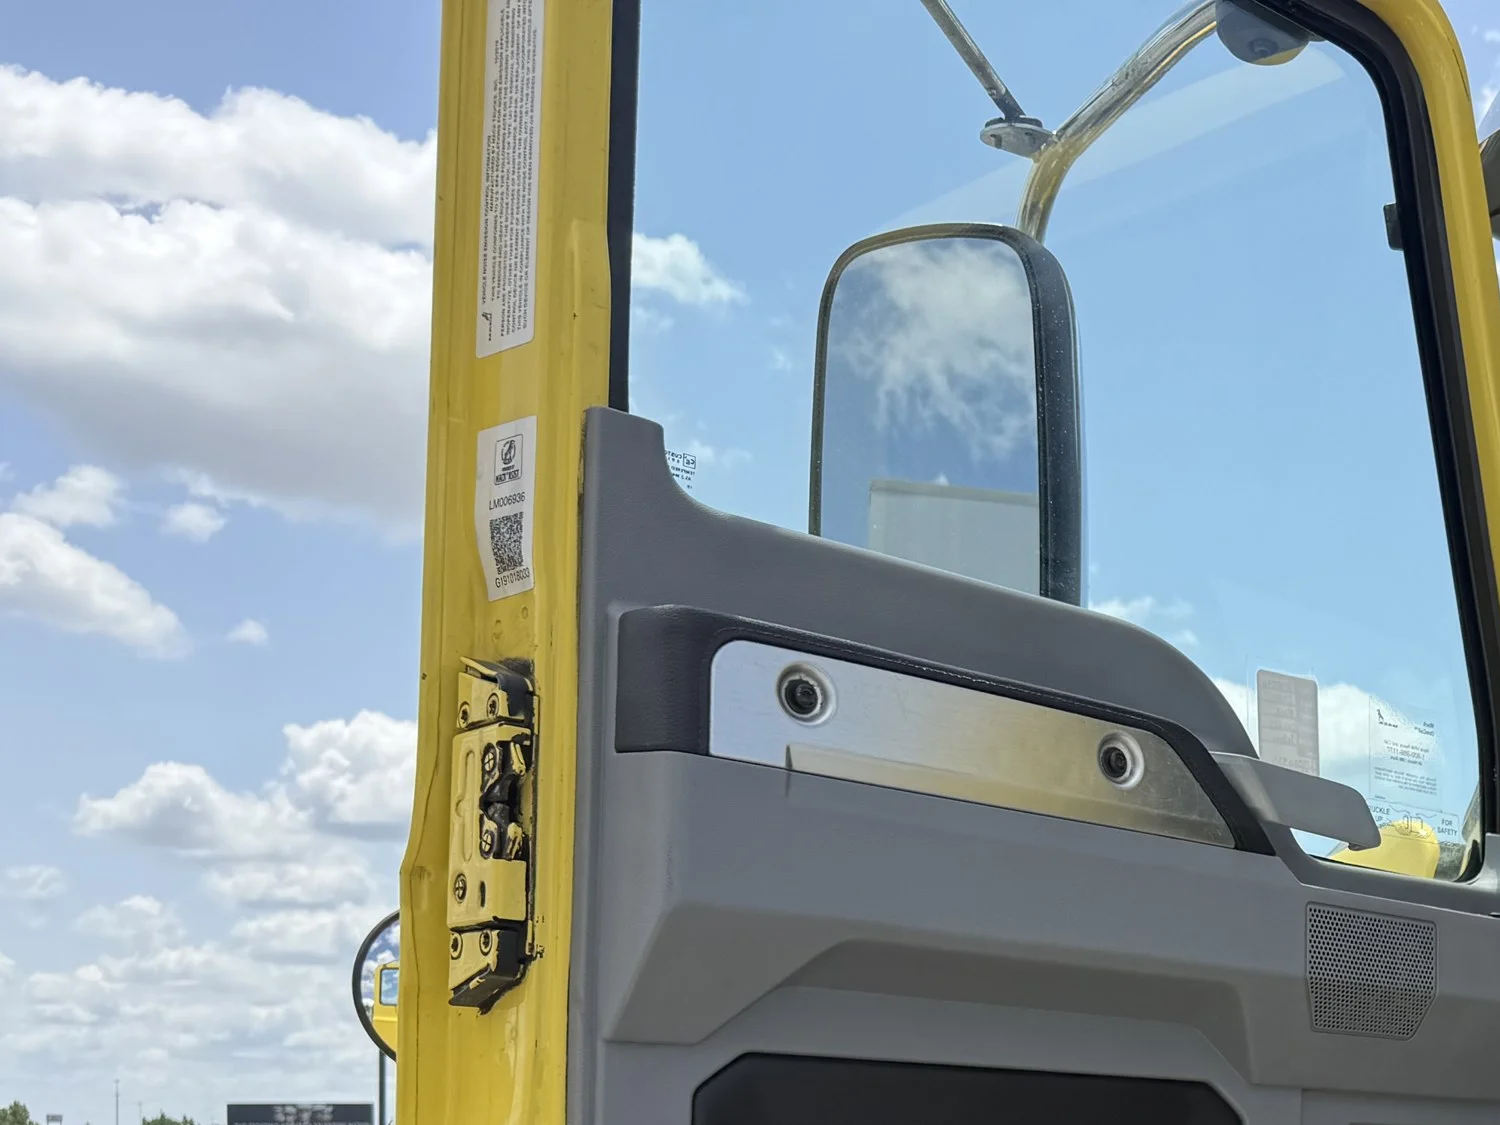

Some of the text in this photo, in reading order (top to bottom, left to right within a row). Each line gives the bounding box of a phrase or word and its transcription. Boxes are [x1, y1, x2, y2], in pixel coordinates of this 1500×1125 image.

[489, 492, 525, 510] LM006936
[1369, 806, 1390, 815] UCKLE
[1437, 827, 1457, 836] SAFETY
